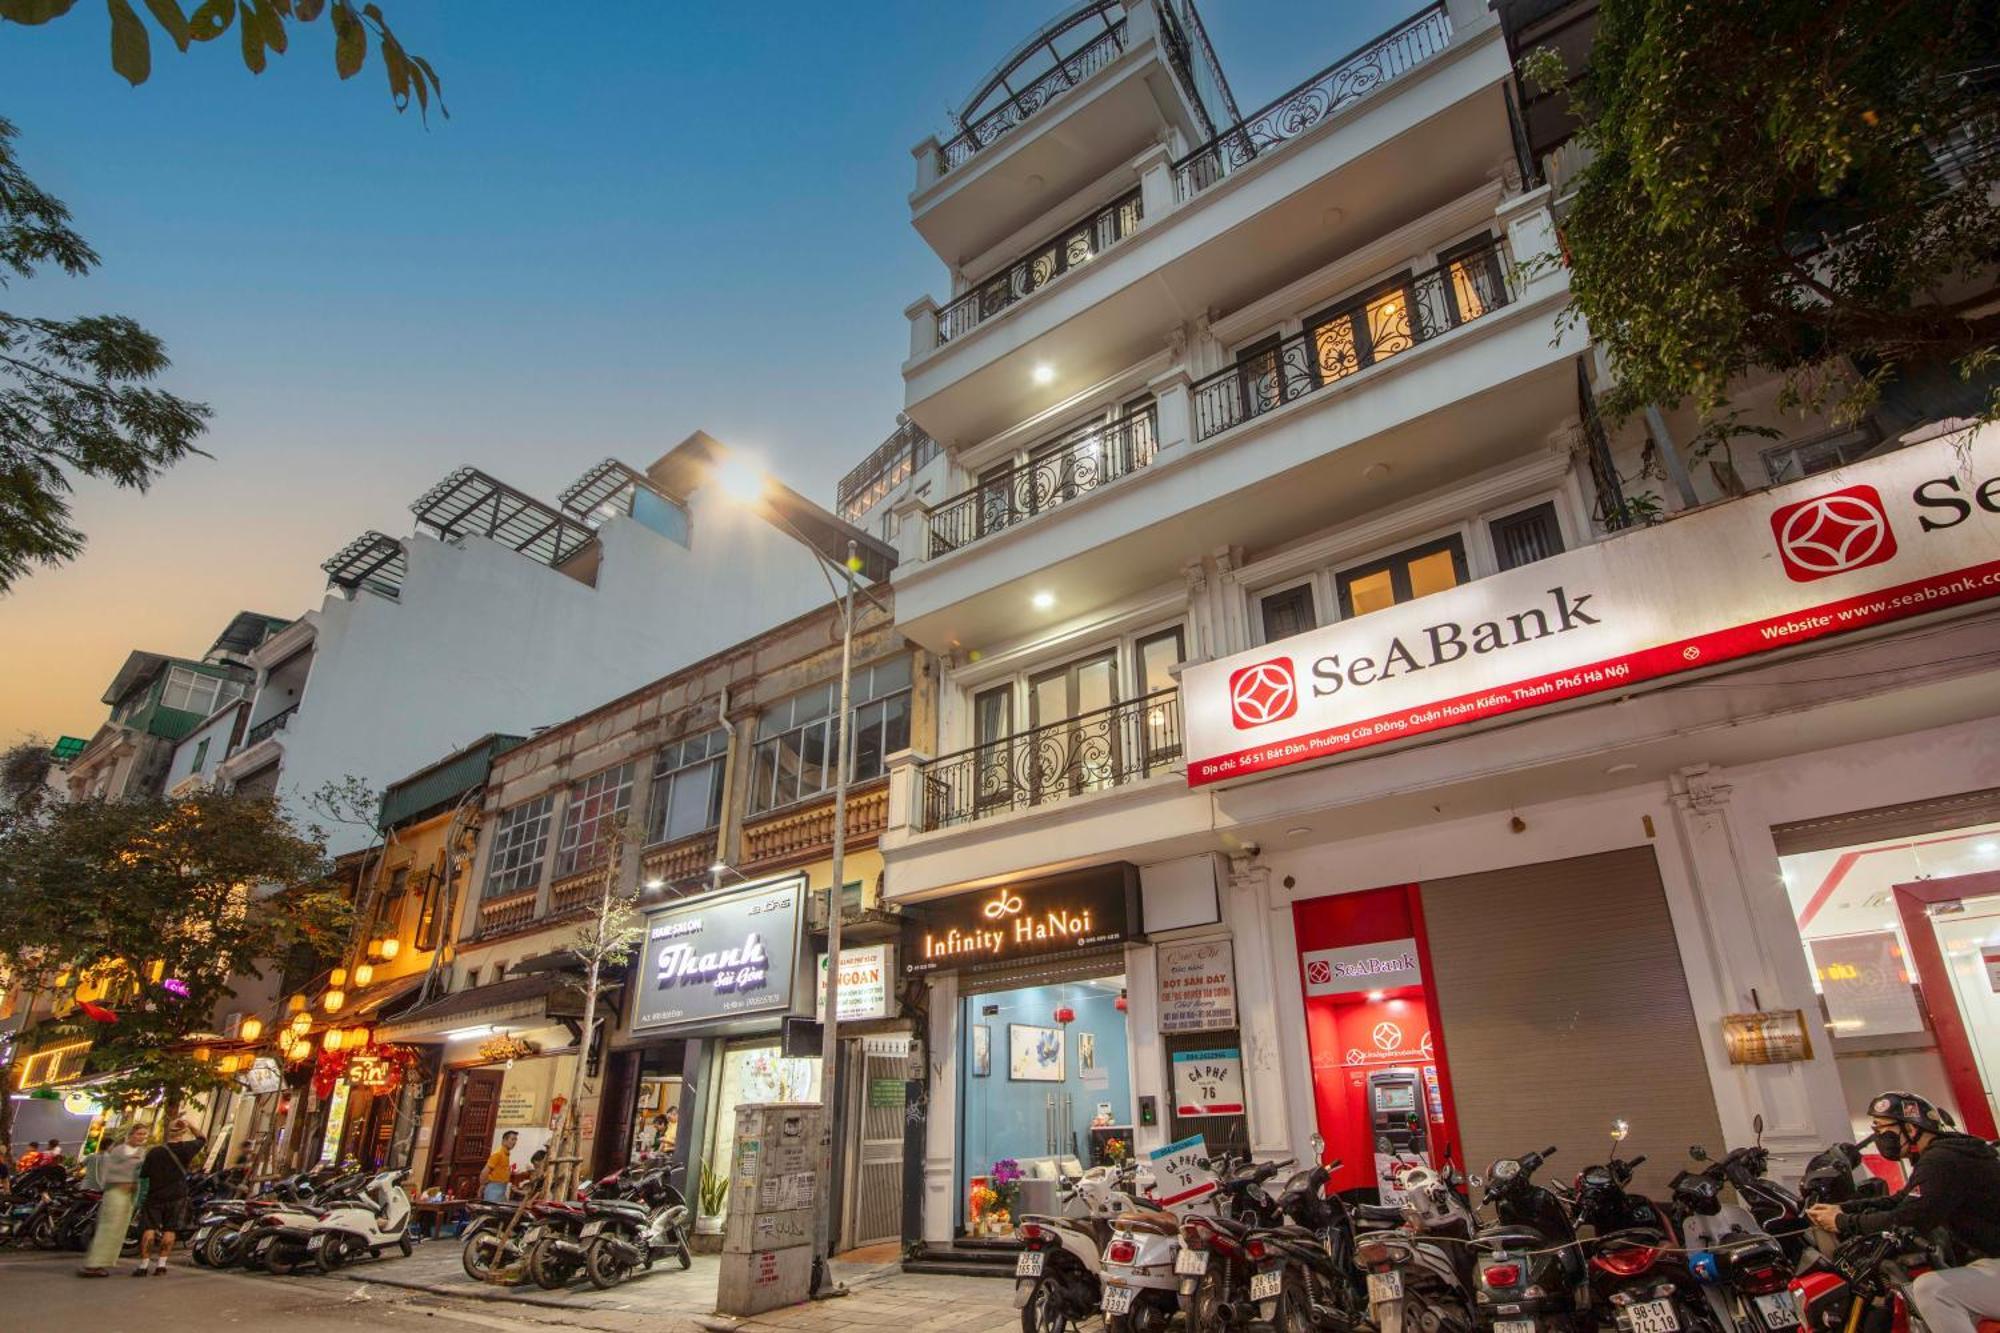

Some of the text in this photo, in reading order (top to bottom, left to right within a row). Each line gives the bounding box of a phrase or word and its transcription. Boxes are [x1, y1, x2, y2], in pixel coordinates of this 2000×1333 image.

[1312, 586, 1601, 697] SeABank
[1442, 702, 1475, 717] Hoàn
[1511, 682, 1554, 700] Thành
[1555, 672, 1582, 690] Phố
[1583, 670, 1603, 684] Hà
[1604, 662, 1630, 679] Nội
[925, 910, 1091, 959] Infinity HaNoi
[657, 932, 766, 980] Thanh
[1335, 953, 1416, 977] SeABank
[1201, 1086, 1216, 1099] 76
[1179, 1173, 1192, 1187] 76
[1633, 1301, 1666, 1319] 98-C1
